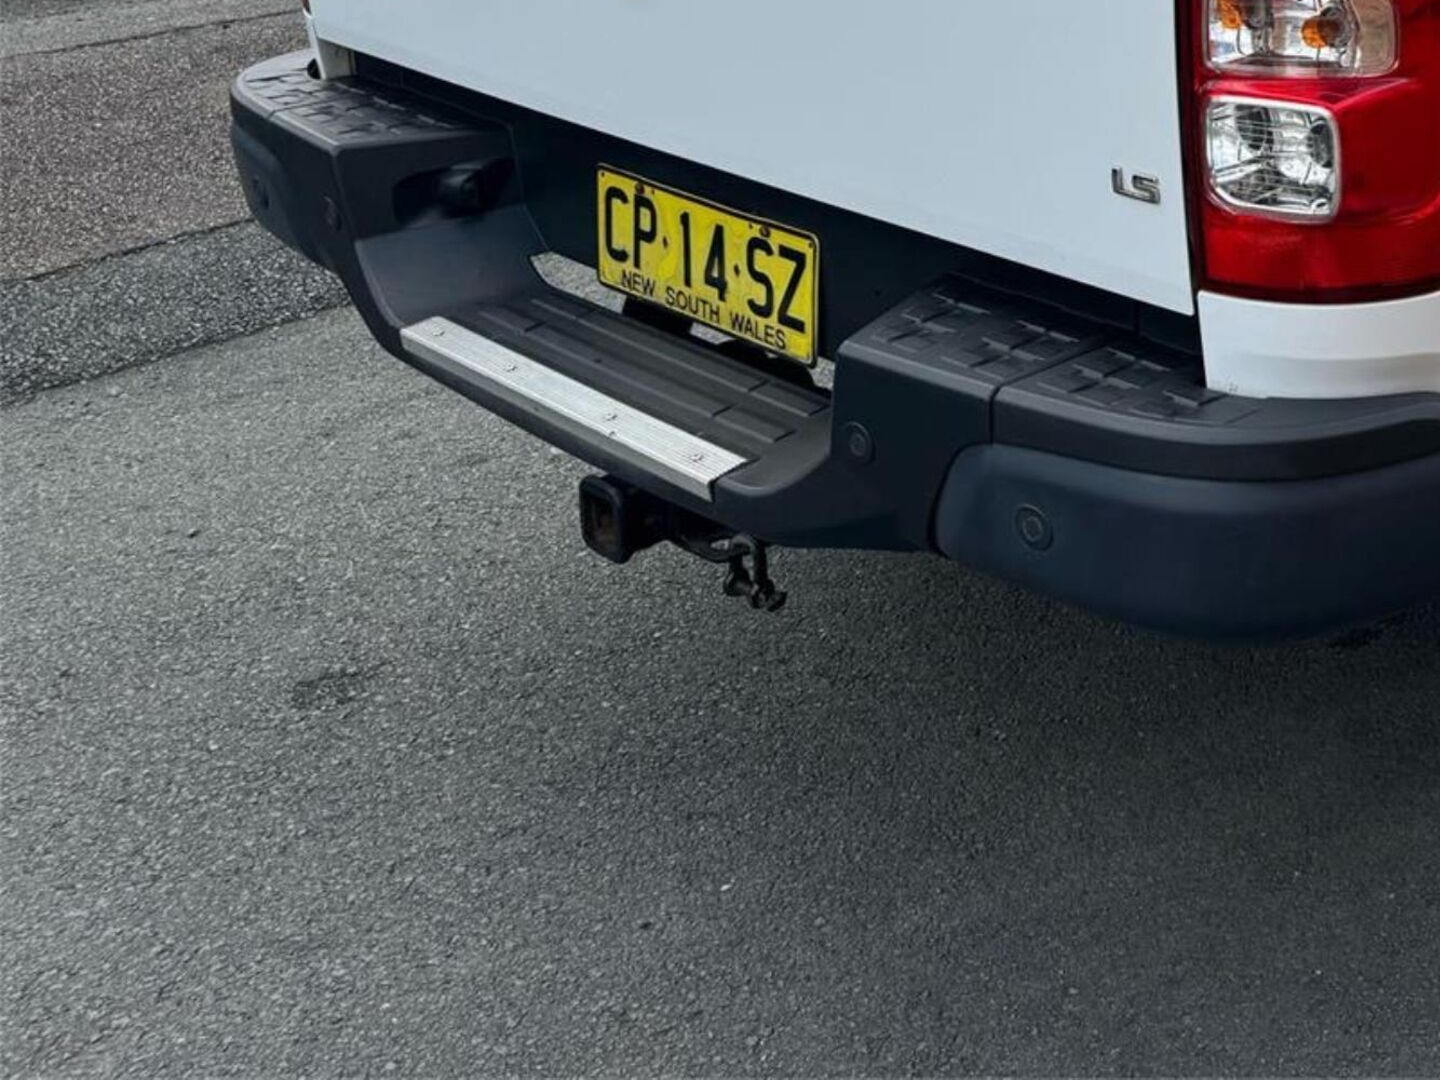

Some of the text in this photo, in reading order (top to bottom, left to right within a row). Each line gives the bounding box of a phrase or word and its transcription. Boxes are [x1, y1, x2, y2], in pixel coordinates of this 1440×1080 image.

[1111, 167, 1160, 205] LS
[621, 270, 787, 351] NEW SOUTH WALES
